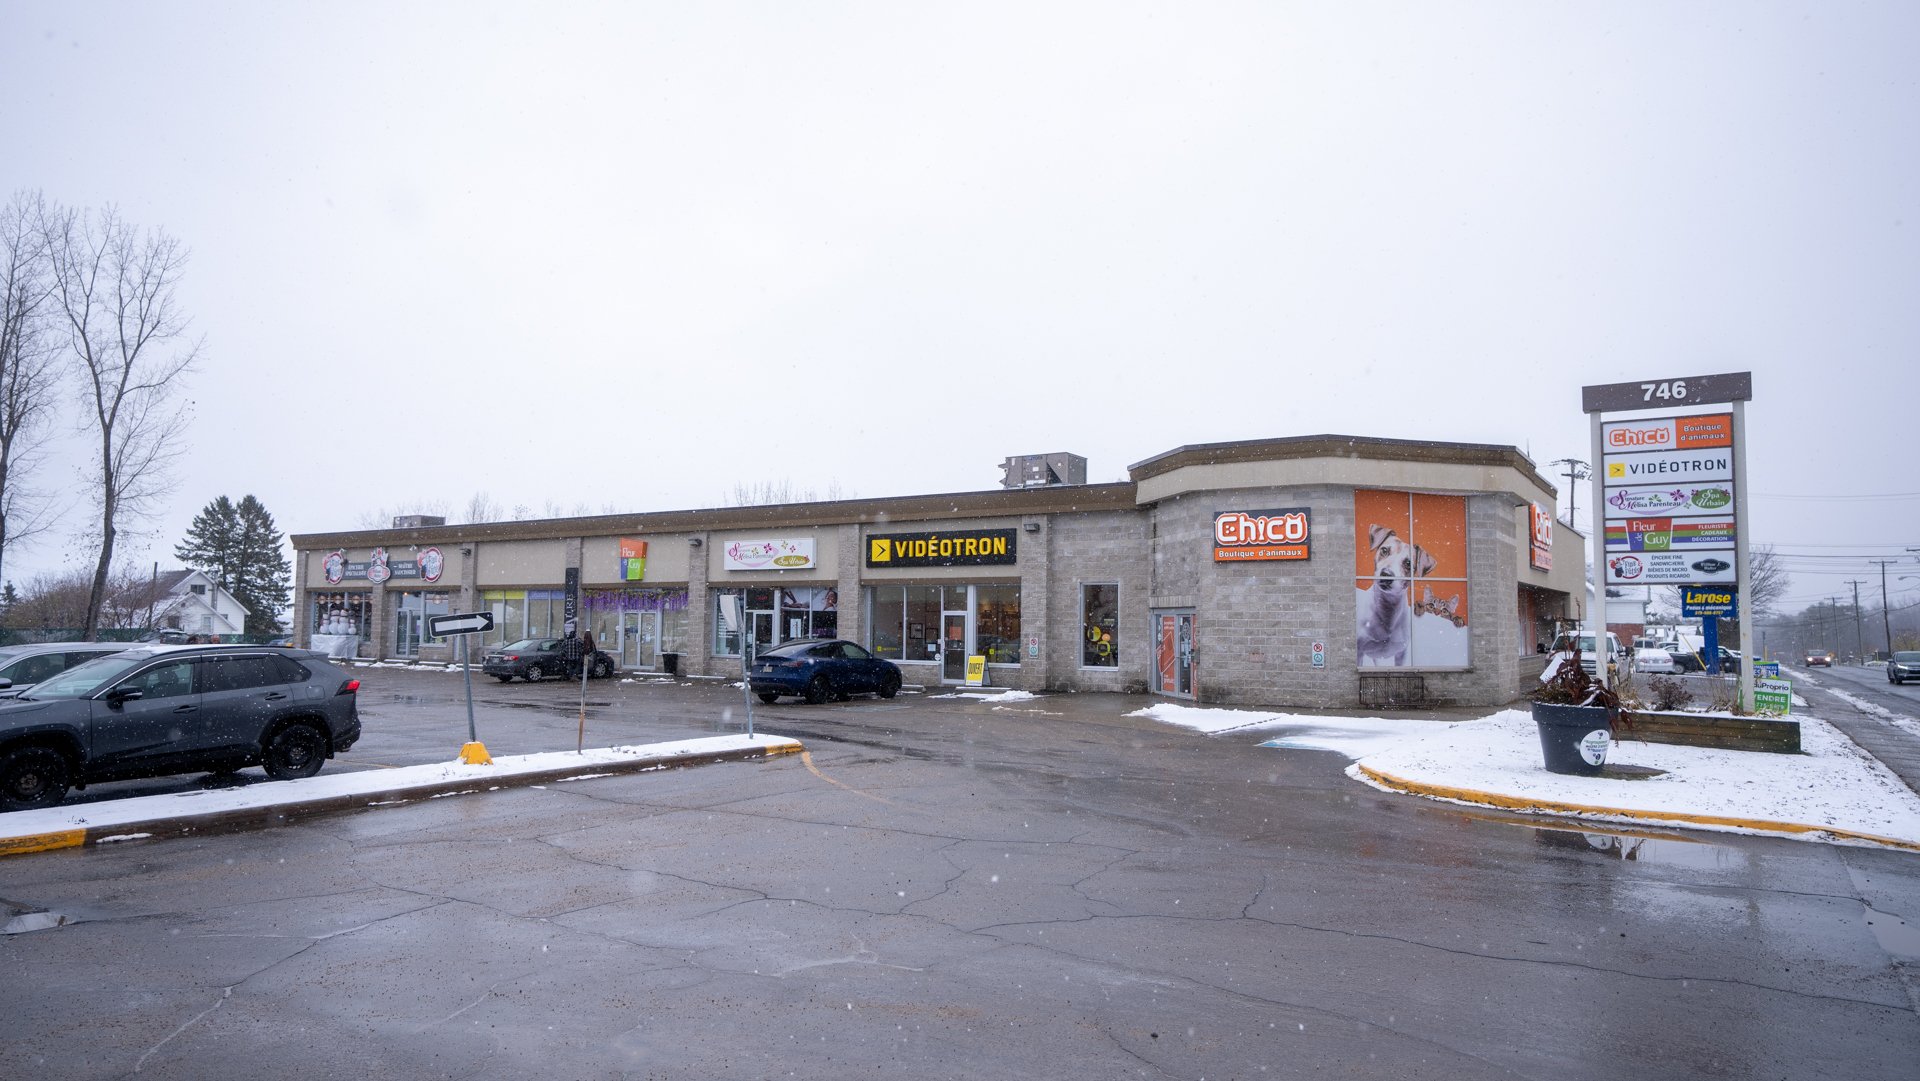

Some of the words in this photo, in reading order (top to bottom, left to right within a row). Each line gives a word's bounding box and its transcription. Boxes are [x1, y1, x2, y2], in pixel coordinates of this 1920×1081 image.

[1641, 381, 1687, 401] 746
[1683, 424, 1722, 433] Boutique
[1610, 428, 1669, 446] Chico
[1680, 432, 1725, 441] d'animaux
[1629, 458, 1727, 475] VIDÉOTRON
[1701, 489, 1720, 500] Spa
[1696, 499, 1725, 507] Urbain
[1216, 513, 1306, 544] Chico
[1633, 521, 1656, 532] Fleur
[1634, 532, 1643, 542] de
[1644, 532, 1669, 547] Guy
[622, 547, 635, 557] Fleur
[895, 535, 1007, 558] VIDÉOTRON
[1218, 550, 1255, 558] Boutique
[1686, 591, 1731, 604] Larose
[968, 661, 983, 674] OUVERT
